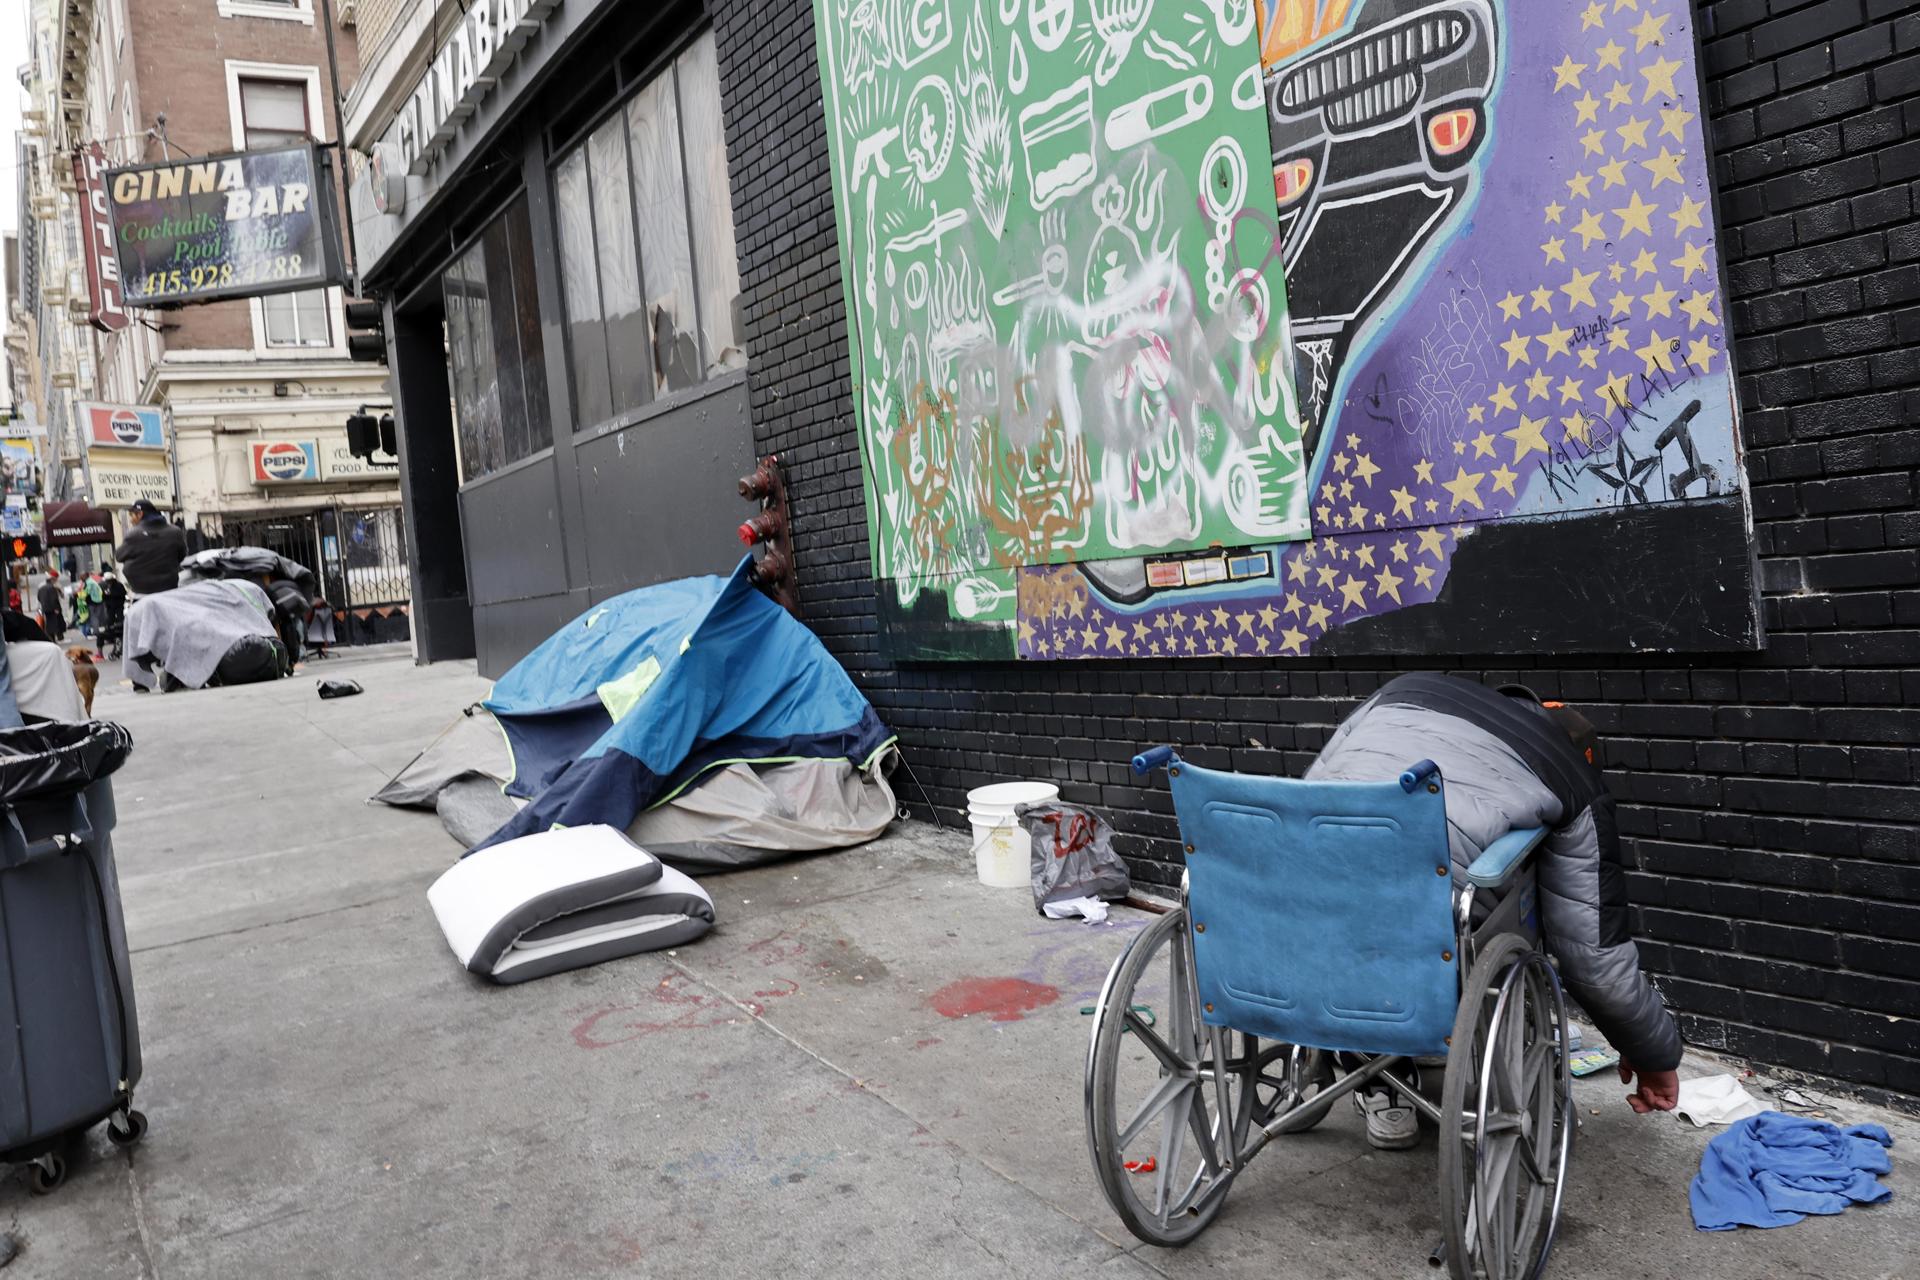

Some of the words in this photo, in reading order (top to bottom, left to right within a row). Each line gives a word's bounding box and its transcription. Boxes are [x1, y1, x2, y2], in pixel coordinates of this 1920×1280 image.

[397, 0, 537, 177] CINNABA
[113, 158, 245, 205] CINNA
[224, 182, 309, 221] BAR
[120, 212, 217, 244] Cocktails
[174, 235, 223, 262] Pool
[112, 421, 143, 433] PEPSI
[263, 455, 307, 467] PEPSI
[331, 463, 361, 473] FOOD
[140, 488, 166, 500] WINE
[52, 527, 82, 537] RIVIERA
[82, 525, 107, 535] HOTEL
